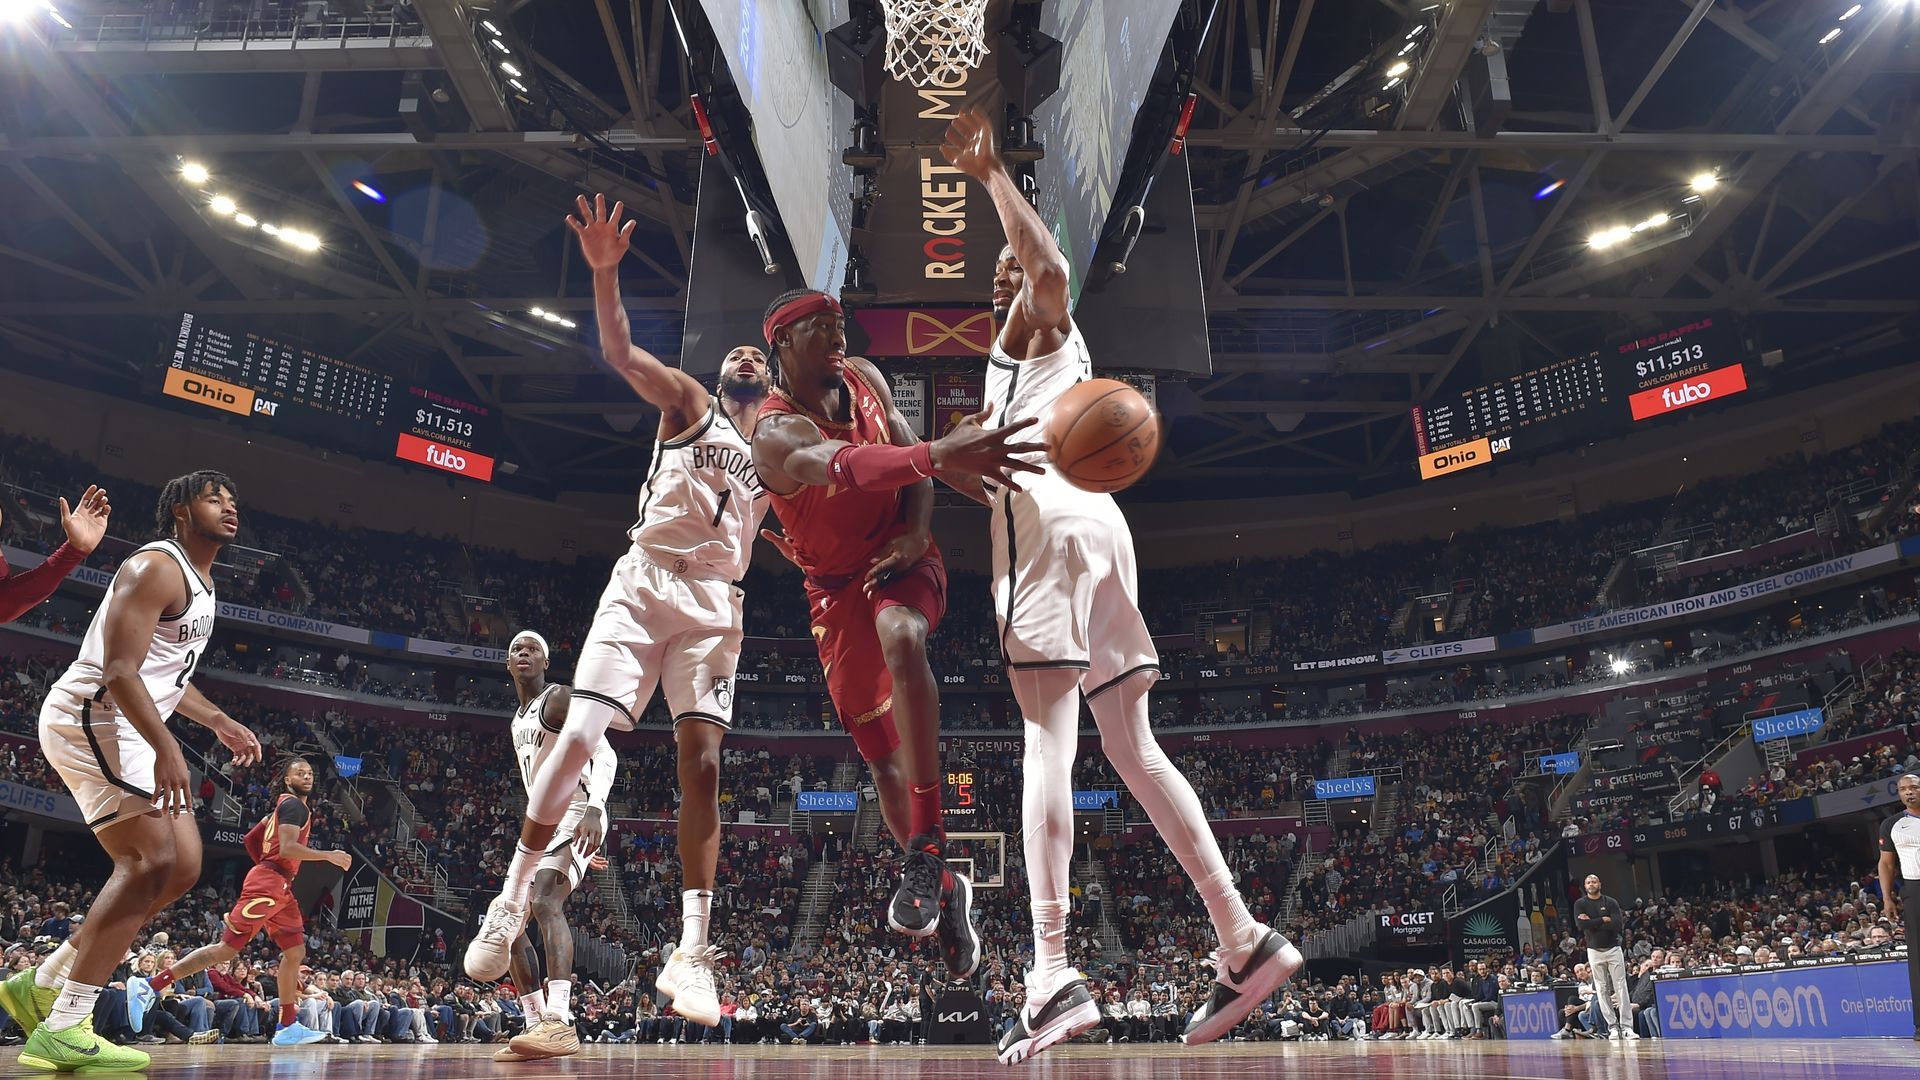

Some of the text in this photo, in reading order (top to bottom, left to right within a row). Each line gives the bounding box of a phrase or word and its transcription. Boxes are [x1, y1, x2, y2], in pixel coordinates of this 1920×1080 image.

[921, 158, 966, 278] ROCKET
[172, 313, 194, 369] BROOKLYN NETS
[207, 337, 233, 349] Schroder
[208, 329, 230, 341] Bridges
[206, 344, 227, 355] Thomas
[202, 359, 223, 370] Claxton
[203, 351, 239, 367] Finney-Smith
[1636, 344, 1704, 378] $11,513
[183, 379, 235, 404] Ohio
[892, 390, 915, 398] STERN
[950, 389, 966, 397] NBA
[1662, 382, 1711, 408] fubo
[254, 398, 278, 416] CAT
[937, 397, 979, 406] CHAMPIONS
[415, 408, 473, 437] $11,513
[1435, 411, 1453, 421] Garland
[1491, 437, 1511, 454] CAT
[426, 445, 466, 471] fubo
[1434, 451, 1476, 469] Ohio
[693, 445, 760, 492] BROOKL
[712, 489, 732, 528] 1
[1570, 558, 1853, 634] THE AMERICAN IRON AND STEEL COMPANY
[221, 604, 333, 635] STEEL COMPANY
[1410, 643, 1463, 659] CLIFFS
[175, 649, 197, 689] 2
[1294, 655, 1378, 671] LET EM KNOW.
[735, 673, 759, 681] OULS
[944, 674, 999, 684] 8:06 3Q
[1200, 670, 1218, 678] TOL
[1225, 668, 1231, 677] 5
[1265, 665, 1278, 673] PM
[1755, 712, 1820, 737] Sheely's
[948, 773, 973, 784] 8:06
[1317, 779, 1371, 794] Sheely's
[0, 783, 56, 812] CLIFFS
[800, 794, 853, 807] Sheely's
[958, 785, 971, 805] 5
[214, 830, 245, 844] ASSIS
[1607, 835, 1622, 848] 62
[1664, 828, 1687, 839] 8:06
[1729, 816, 1743, 830] 67
[349, 894, 374, 906] IN THE
[348, 906, 373, 919] PAINT
[1381, 911, 1434, 927] ROCKET
[1393, 926, 1424, 934] Mortgage
[1841, 999, 1864, 1013] One
[1508, 1001, 1557, 1033] zoom
